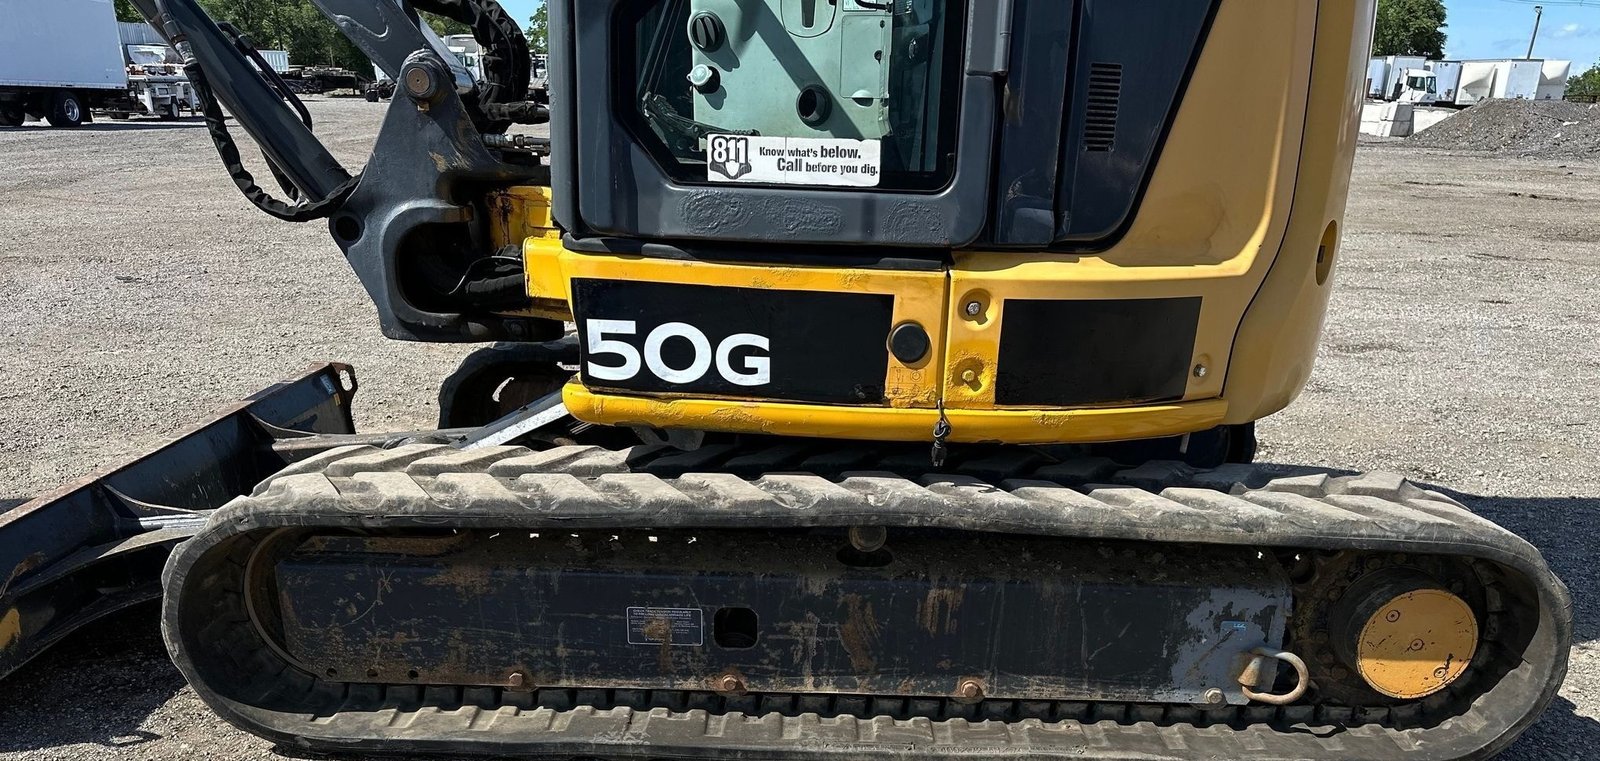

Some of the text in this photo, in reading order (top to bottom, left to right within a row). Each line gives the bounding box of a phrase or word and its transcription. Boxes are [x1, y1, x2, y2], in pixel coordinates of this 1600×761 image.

[713, 137, 747, 163] 811
[759, 145, 862, 159] Know what's below.
[776, 157, 879, 176] Call before you dig.
[586, 318, 771, 387] 50G
